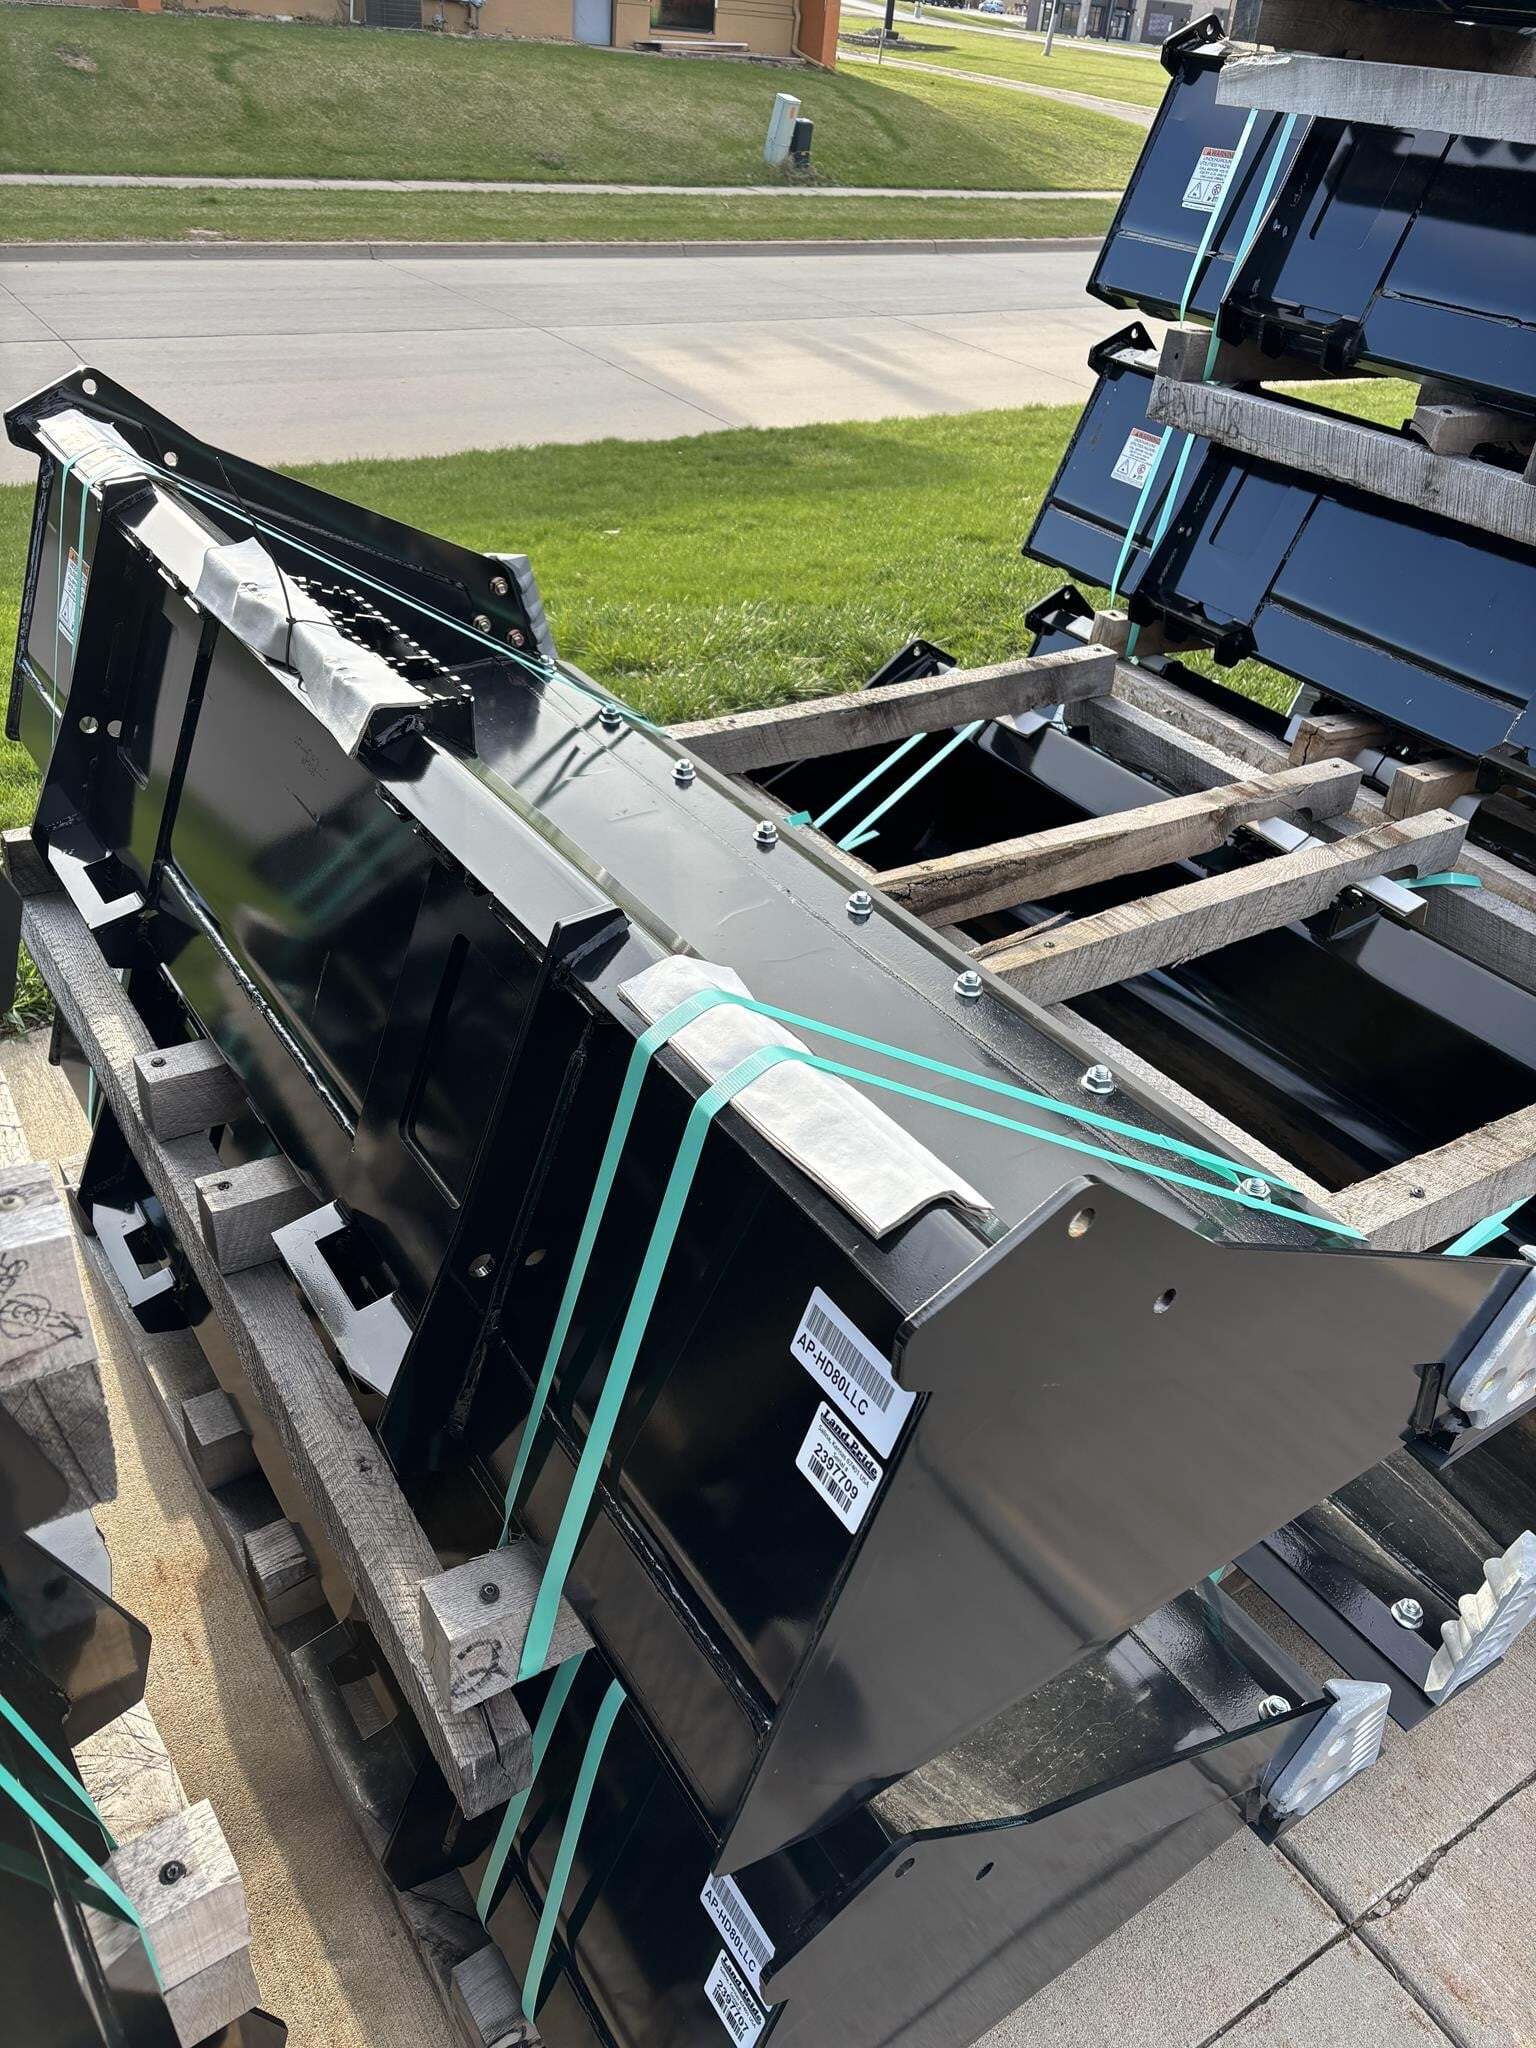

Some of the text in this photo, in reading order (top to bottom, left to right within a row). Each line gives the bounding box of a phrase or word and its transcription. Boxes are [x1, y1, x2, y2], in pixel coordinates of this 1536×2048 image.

[796, 1332, 869, 1415] AP-HD80LLC
[814, 1442, 859, 1500] 2397709
[821, 1409, 879, 1480] Land Pride
[704, 1889, 757, 1973] AP-HD80LLC
[717, 1979, 749, 2033] 2397707
